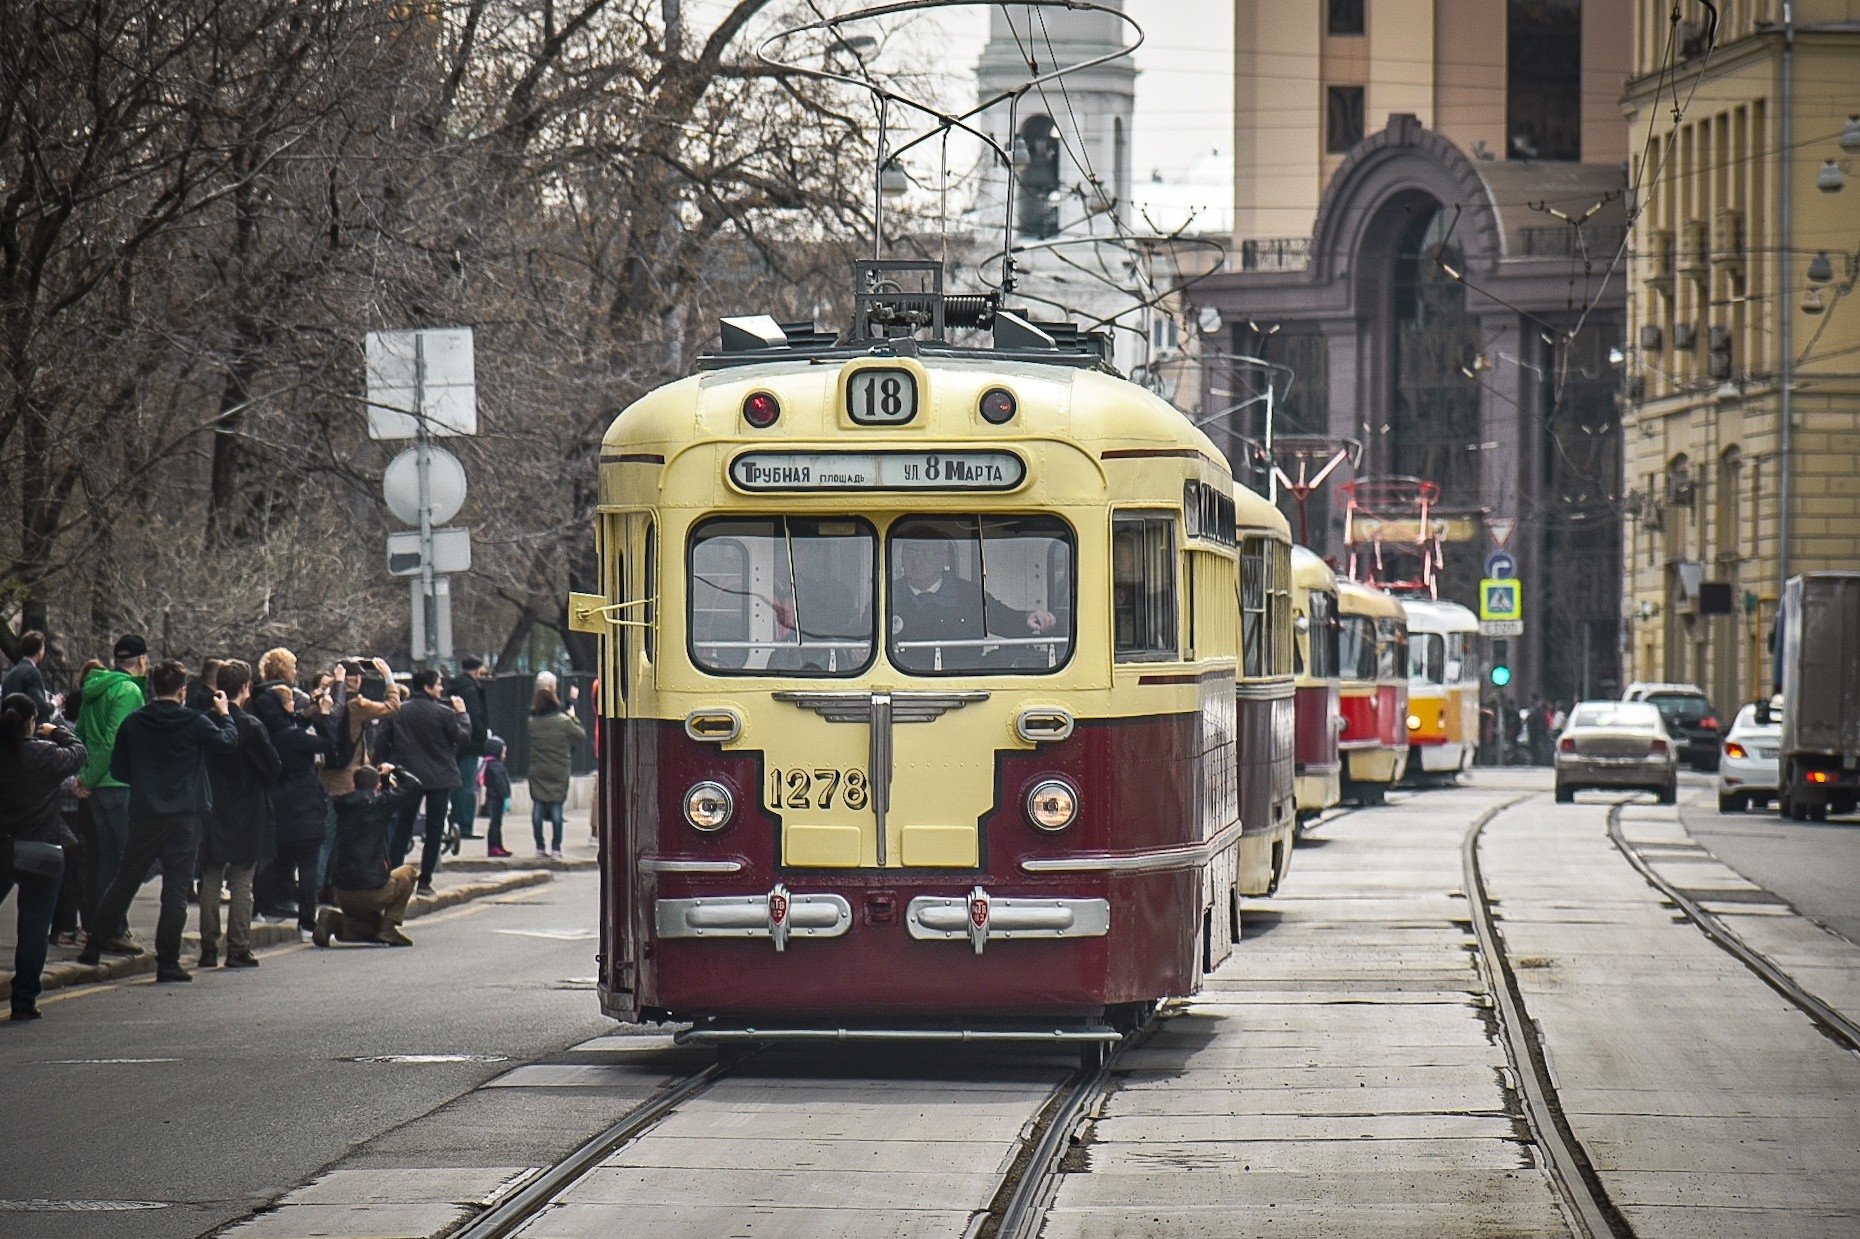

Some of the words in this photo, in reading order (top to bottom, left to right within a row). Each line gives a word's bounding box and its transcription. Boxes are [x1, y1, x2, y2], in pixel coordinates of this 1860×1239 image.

[864, 377, 902, 416] 18
[741, 461, 810, 483] ТРУБНАЯ
[925, 455, 940, 481] 8
[944, 460, 1003, 481] МАРТА
[770, 768, 868, 810] 1278
